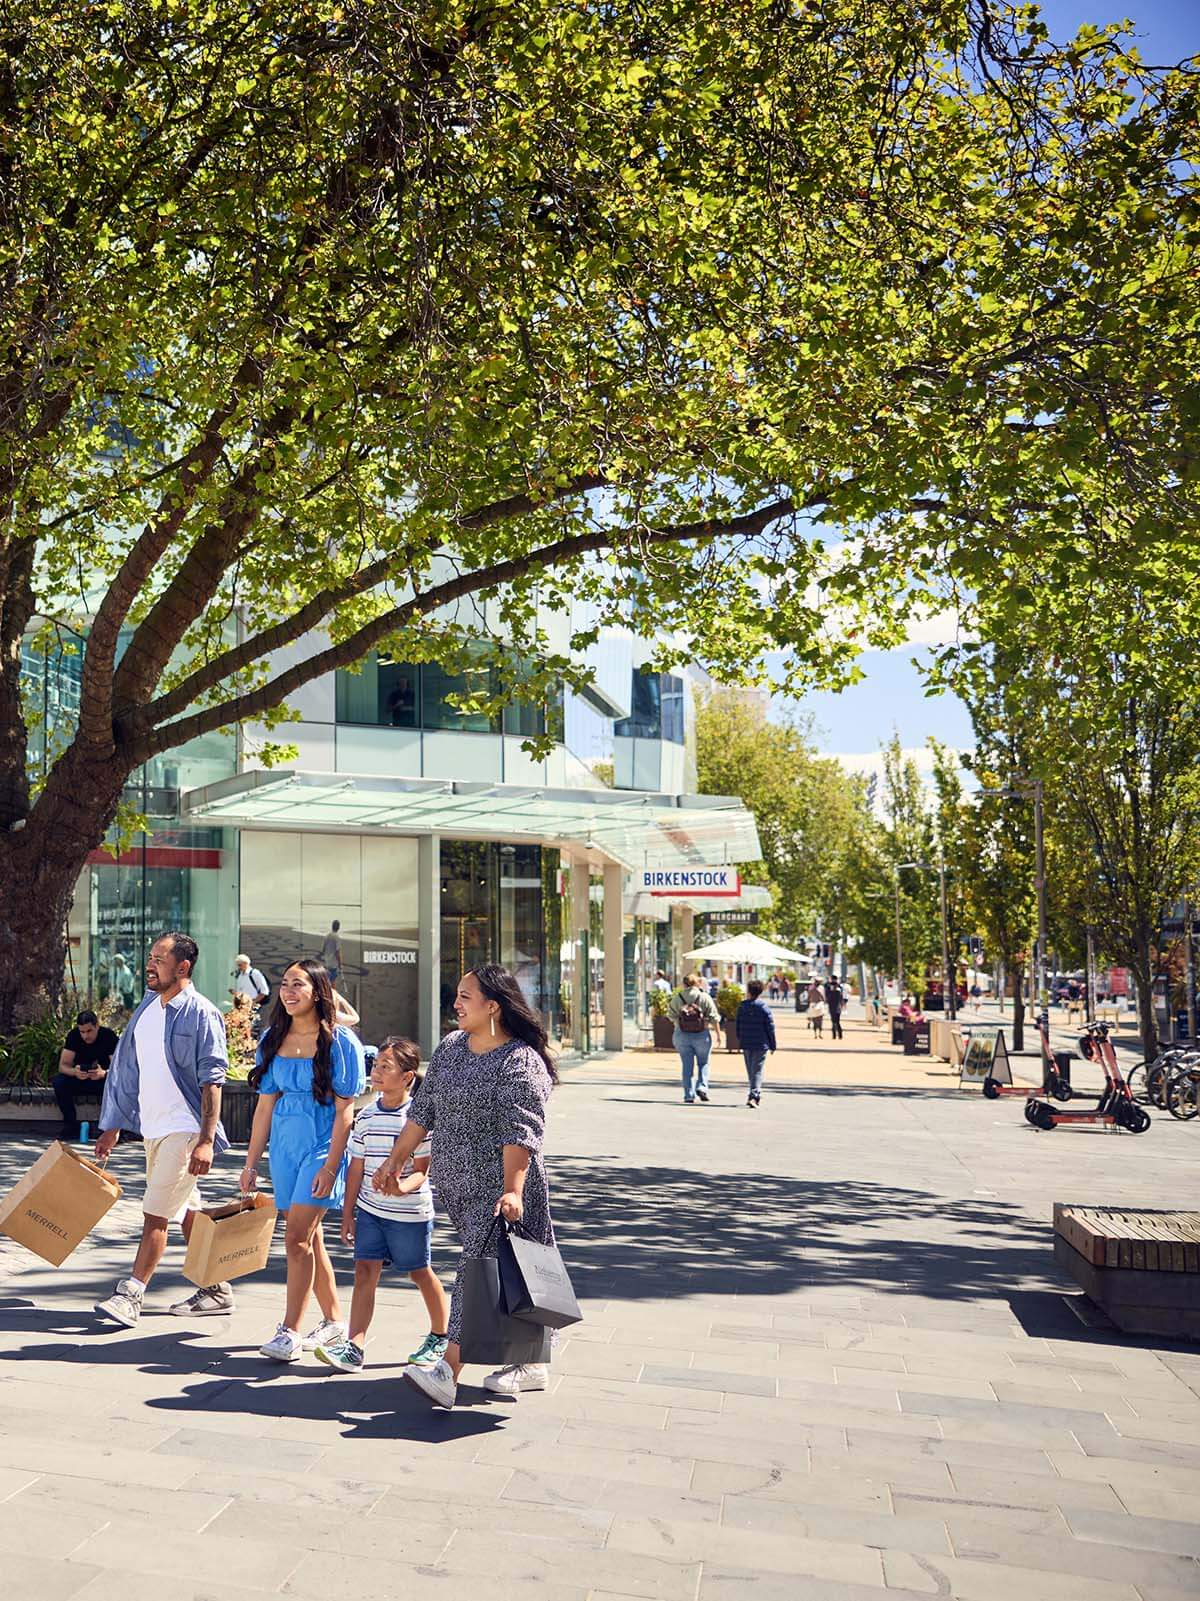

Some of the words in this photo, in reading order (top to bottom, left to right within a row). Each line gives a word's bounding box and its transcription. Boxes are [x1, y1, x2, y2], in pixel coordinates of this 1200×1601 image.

[643, 872, 728, 886] BIRKENSTOCK
[710, 912, 751, 921] MERCHANT
[363, 951, 416, 964] BIRKENSTOCK
[25, 1209, 69, 1241] MERRELL
[216, 1245, 259, 1265] MERRELL
